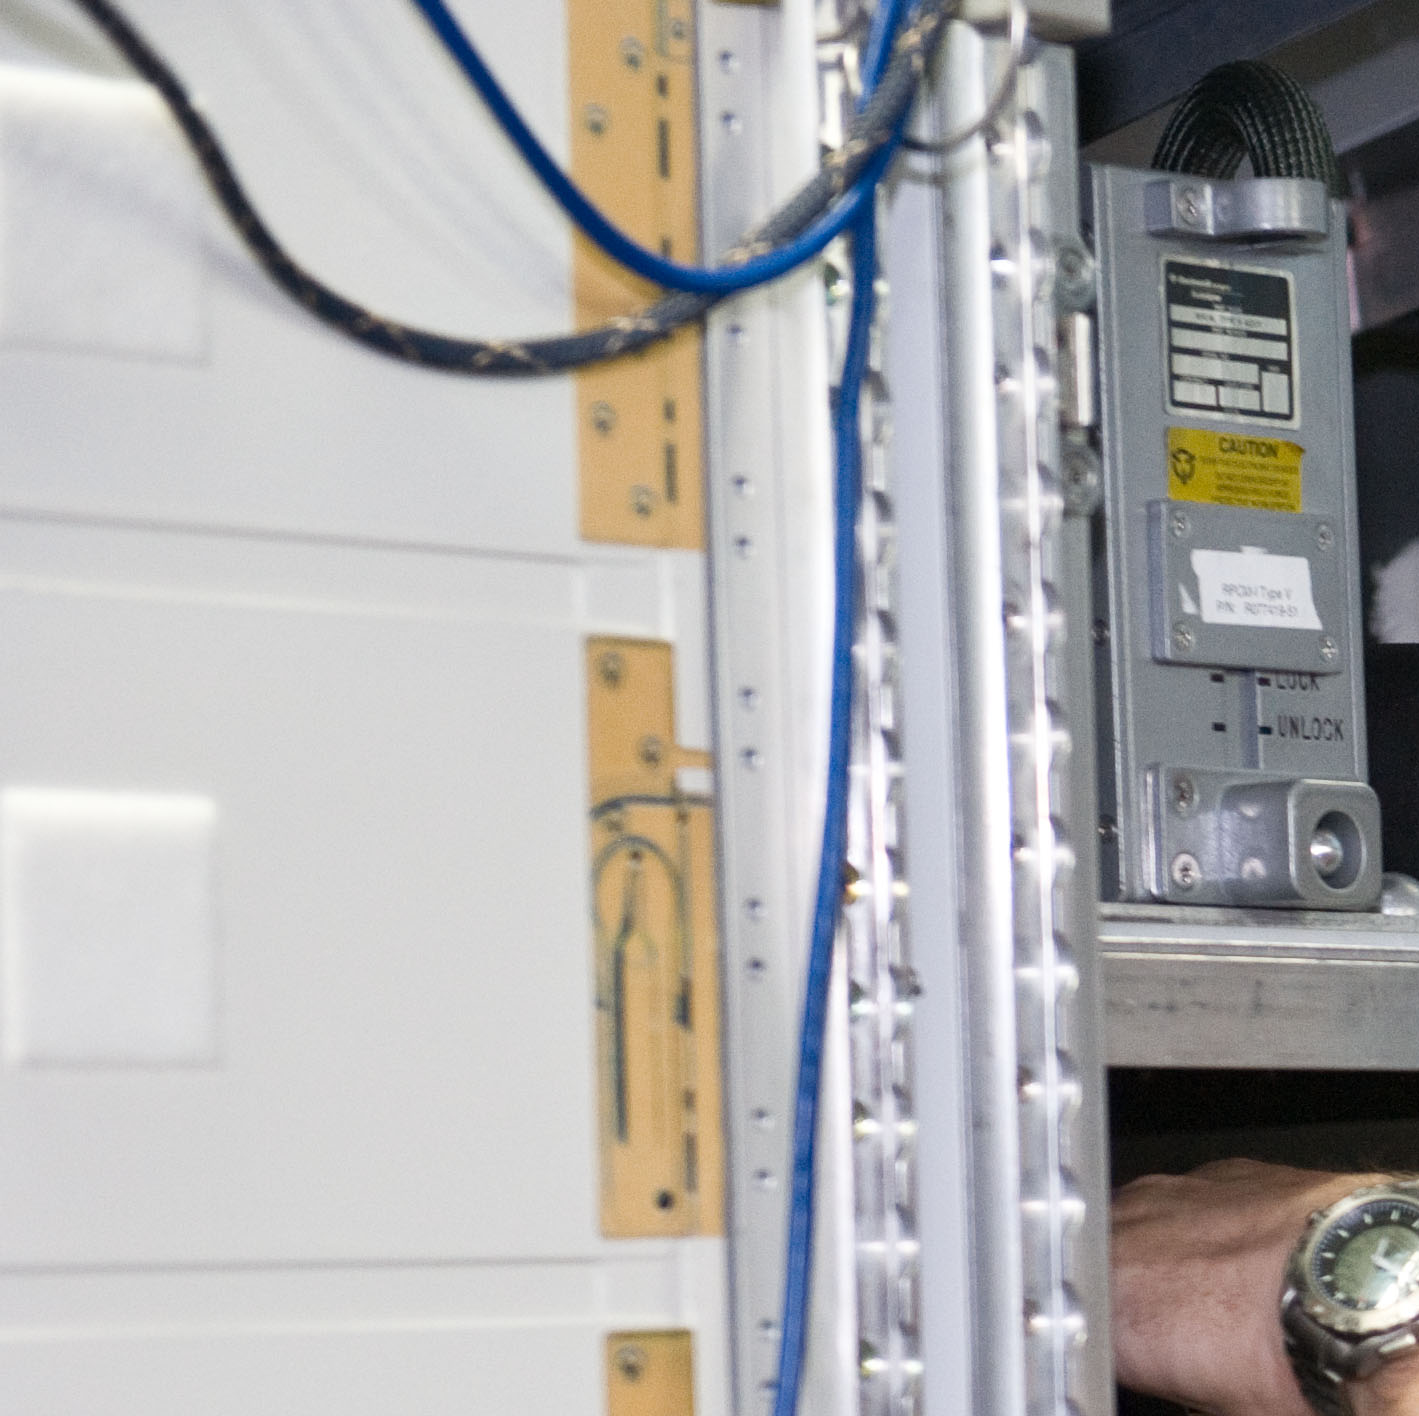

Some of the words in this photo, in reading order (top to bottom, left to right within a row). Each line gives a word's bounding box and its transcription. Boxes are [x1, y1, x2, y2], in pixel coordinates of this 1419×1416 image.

[1219, 436, 1278, 458] CAUTION
[1275, 674, 1320, 691] LOCK
[1277, 715, 1344, 741] UNLOCK
